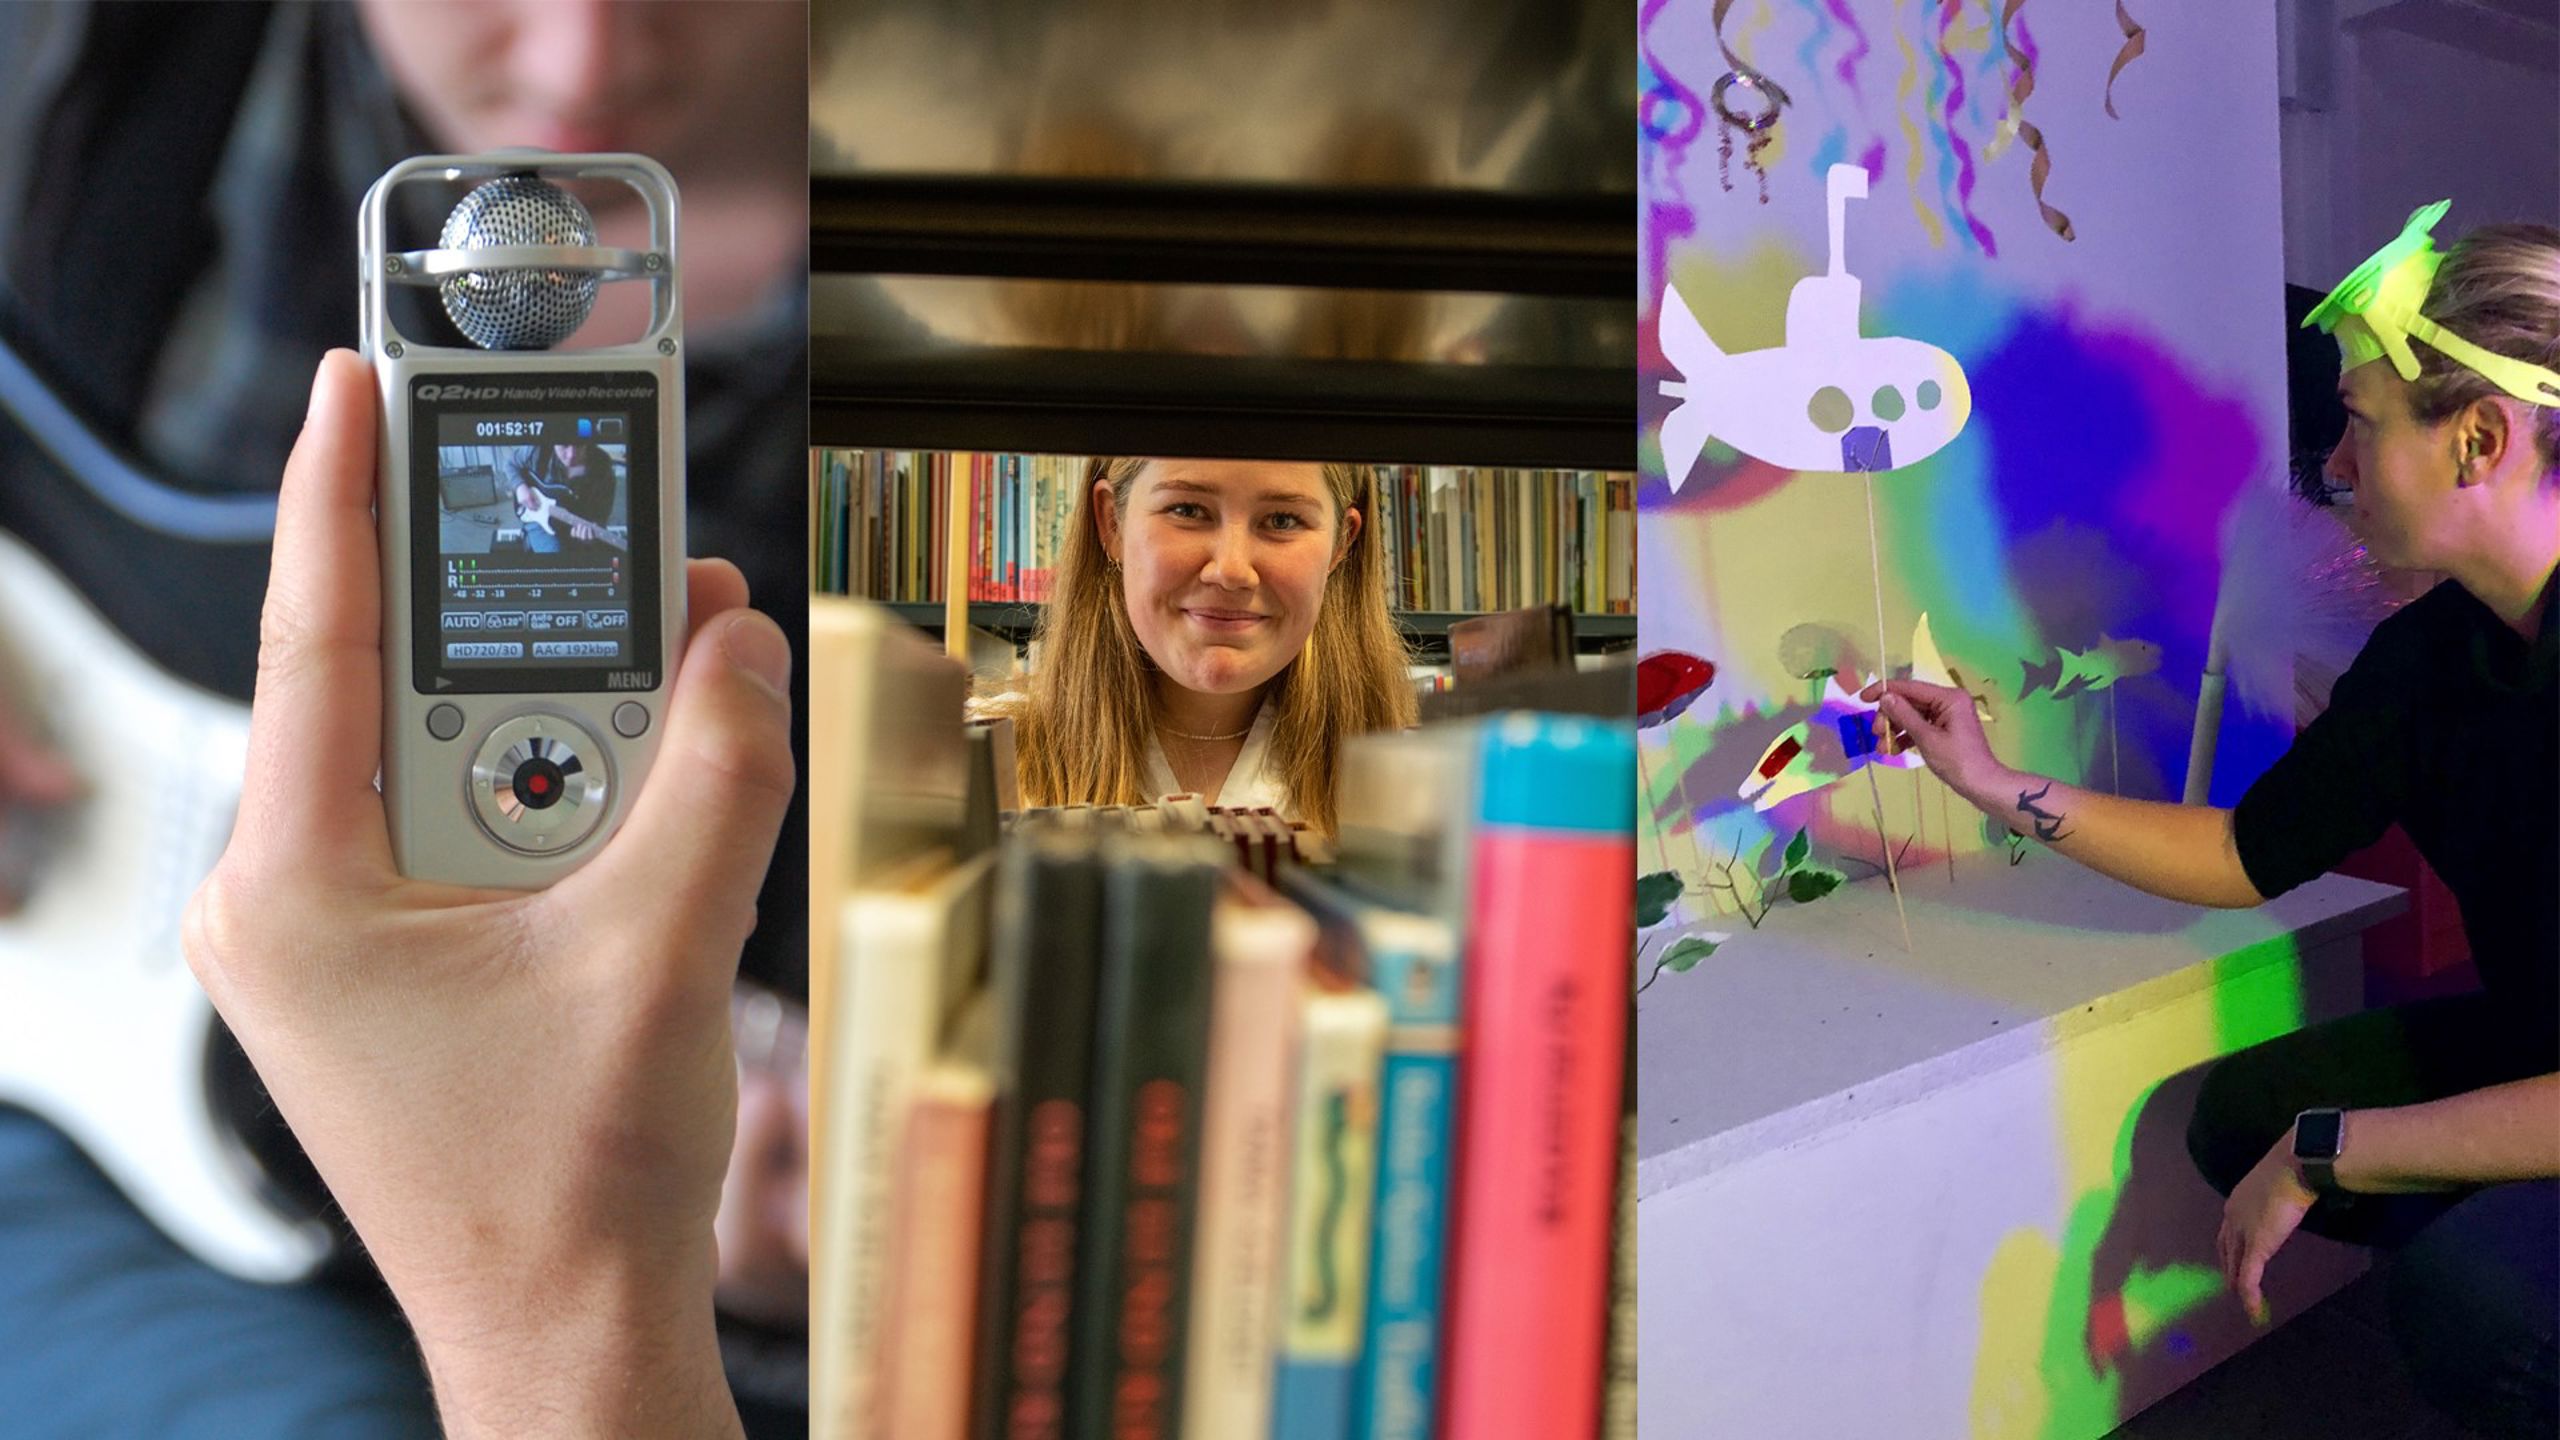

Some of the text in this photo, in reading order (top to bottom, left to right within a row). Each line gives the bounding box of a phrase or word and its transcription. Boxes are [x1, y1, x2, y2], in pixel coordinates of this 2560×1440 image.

[417, 384, 655, 401] Q2HD Handy Video Recorder
[476, 422, 544, 436] 001:52:17
[448, 560, 457, 573] L
[448, 575, 458, 588] R
[444, 616, 480, 628] AUTO
[556, 615, 578, 627] OFF
[602, 615, 625, 626] OFF
[454, 645, 518, 657] HD720/30
[535, 643, 617, 657] AAC 192kbps
[608, 671, 652, 688] MENU
